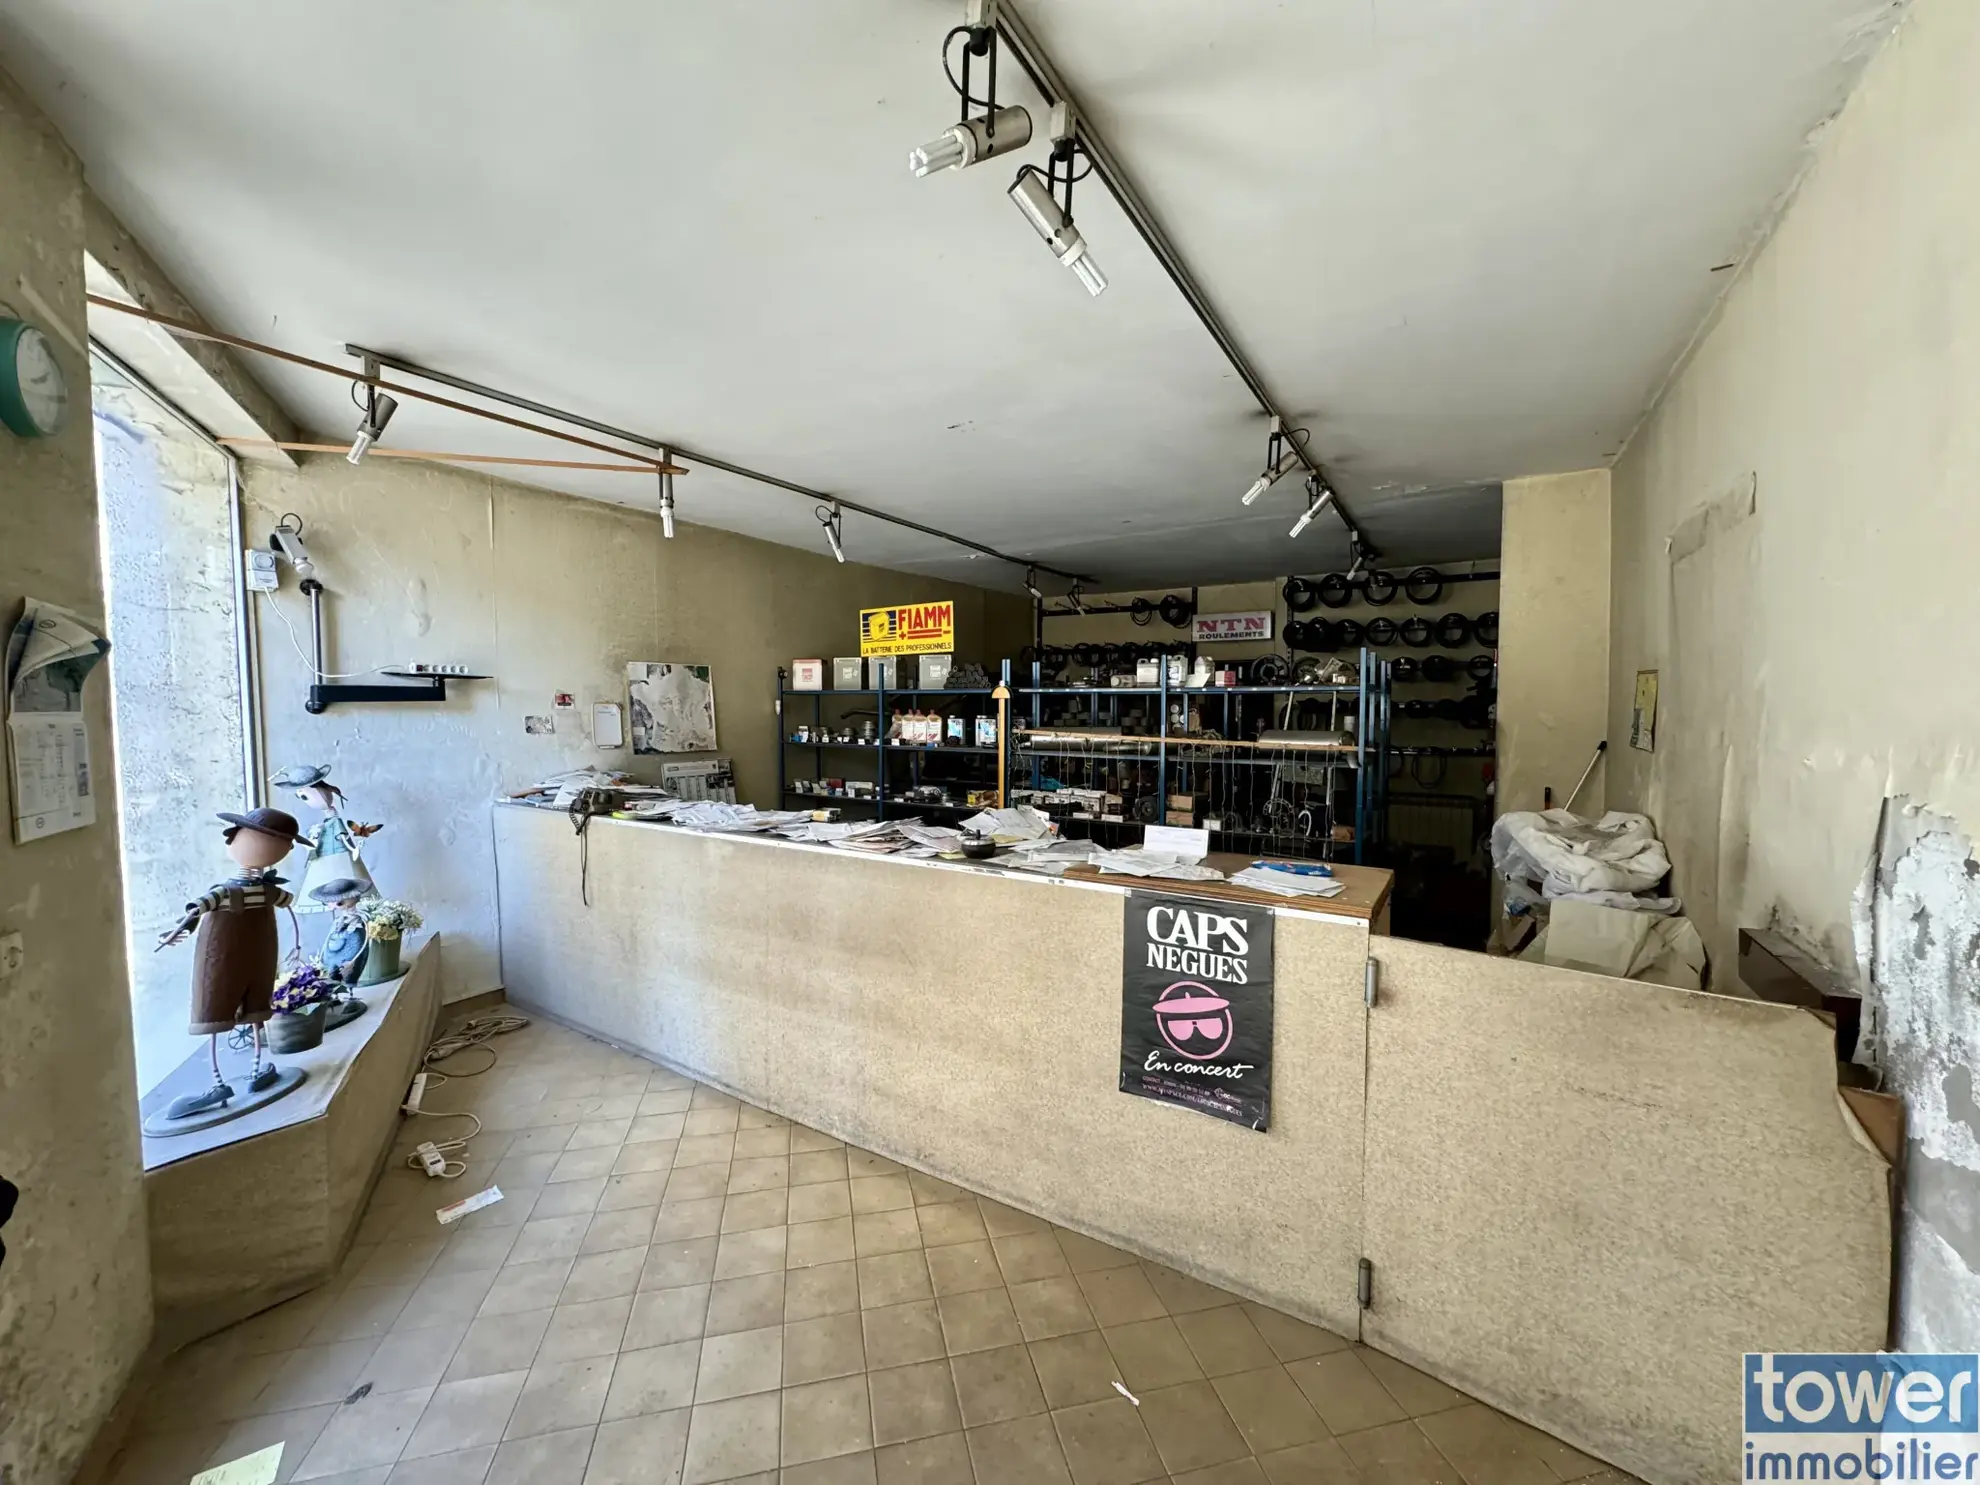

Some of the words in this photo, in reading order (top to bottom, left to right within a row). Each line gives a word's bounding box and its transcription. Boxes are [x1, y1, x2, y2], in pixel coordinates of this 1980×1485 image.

[898, 605, 951, 630] FIAMM
[1197, 617, 1265, 633] NTN
[871, 645, 892, 654] BATTERIE
[894, 643, 904, 652] DES
[906, 642, 952, 651] PROFESSIONNELS
[1199, 631, 1264, 640] ROULEMENTS
[1146, 906, 1249, 956] CAPS
[1146, 942, 1248, 985] NEGUES
[1144, 1050, 1172, 1073] En
[1174, 1058, 1254, 1080] concert
